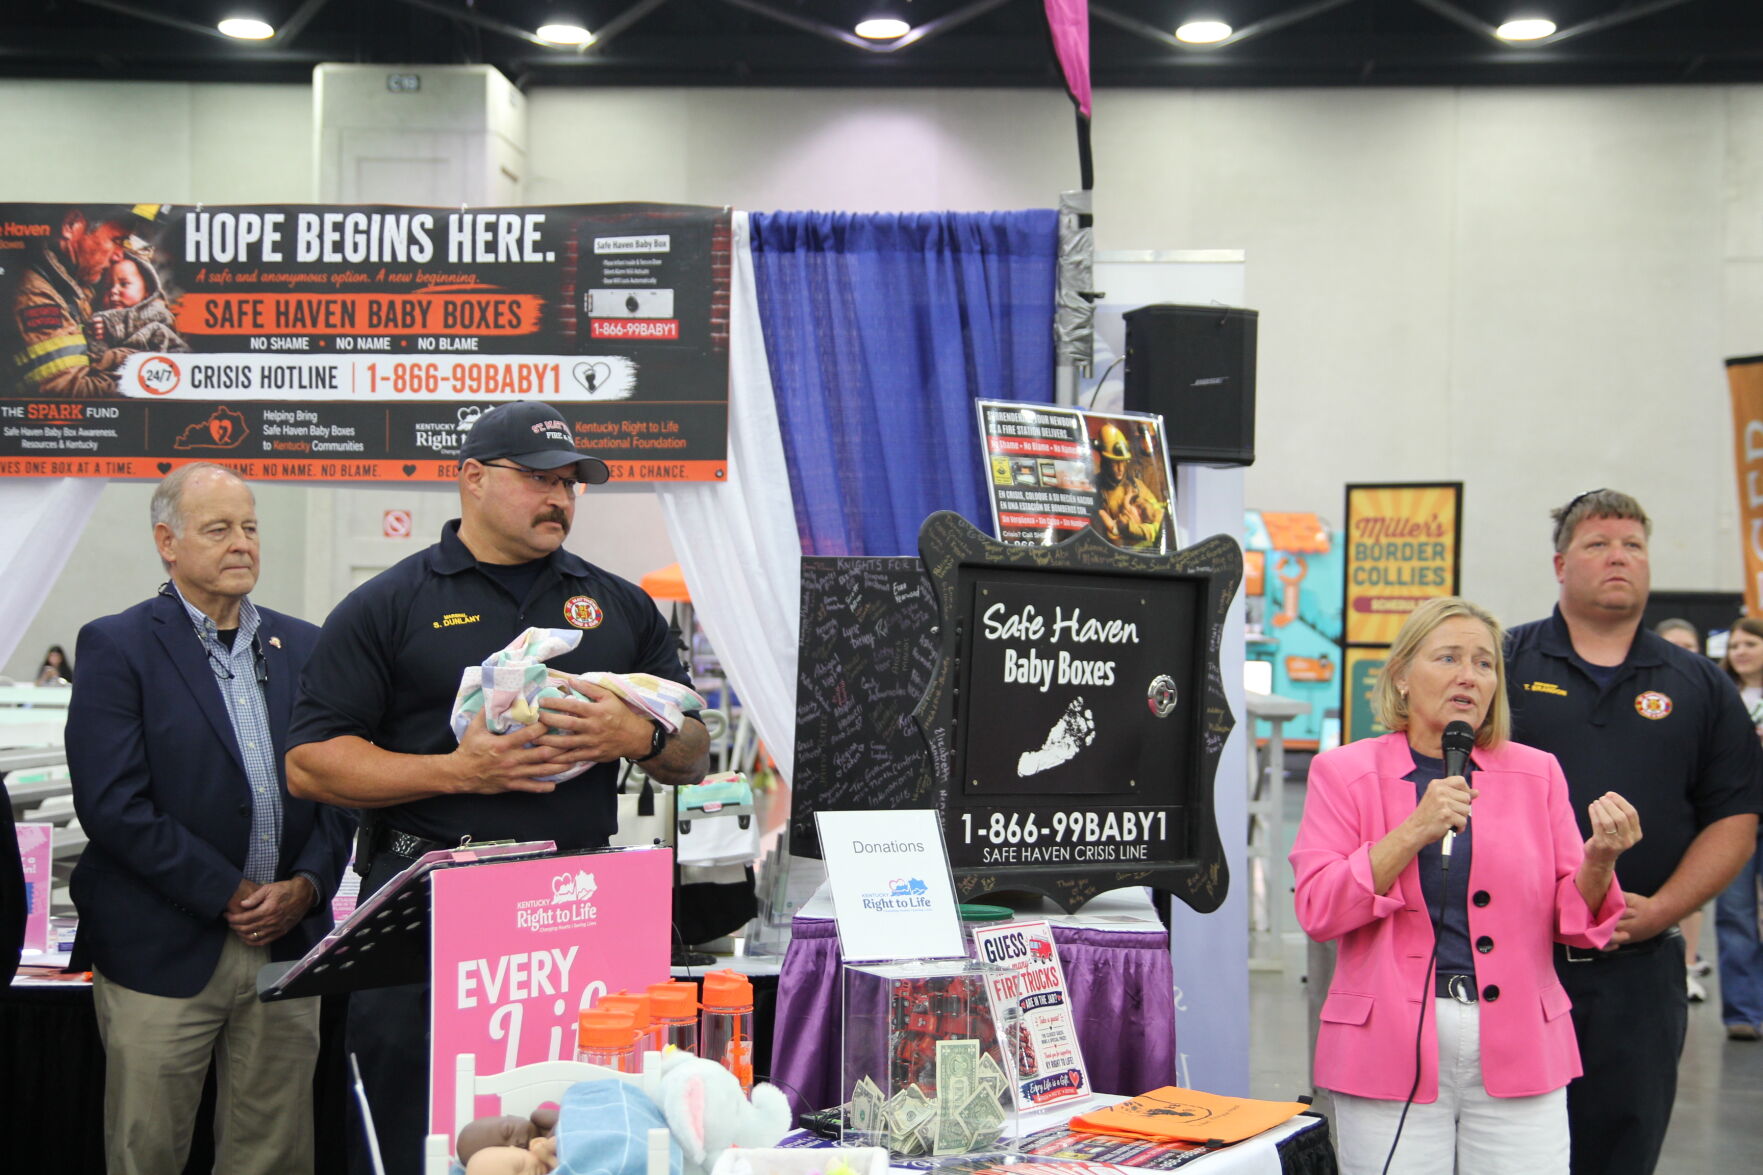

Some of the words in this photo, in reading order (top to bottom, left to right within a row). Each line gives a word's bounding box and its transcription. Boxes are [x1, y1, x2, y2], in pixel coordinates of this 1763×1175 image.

[5, 222, 50, 237] Haven
[186, 213, 285, 263] HOPE
[297, 213, 434, 263] BEGINS
[448, 213, 556, 263] HERE.
[635, 239, 653, 250] Baby
[654, 239, 667, 248] Box
[196, 268, 207, 283] A
[209, 269, 232, 286] safe
[235, 269, 258, 283] and
[261, 273, 327, 288] anonymous
[331, 271, 371, 288] option.
[375, 268, 387, 283] A
[389, 273, 412, 283] new
[416, 269, 480, 288] beginning.
[204, 299, 265, 329] SAFE
[275, 299, 356, 329] HAVEN
[368, 299, 433, 329] BABY
[443, 299, 522, 330] BOXES
[594, 321, 676, 336] 1-866-99BABY1
[251, 337, 267, 350] NO
[270, 337, 310, 350] SHAME
[336, 337, 353, 350] NO
[357, 337, 391, 350] NAME
[418, 337, 436, 350] NO
[439, 337, 479, 350] BLAME
[146, 368, 172, 383] 24/7
[191, 365, 252, 389] CRISIS
[260, 365, 338, 389] HOTLINE
[367, 362, 560, 394] 1-866-99BABY1
[1, 407, 25, 418] THE
[27, 404, 83, 419] SPARK
[86, 408, 119, 418] FUND
[263, 410, 295, 423] Helping
[296, 410, 318, 423] Bring
[263, 425, 281, 436] Safe
[282, 425, 309, 436] Haven
[310, 425, 330, 438] Baby
[331, 425, 355, 436] Boxes
[575, 421, 618, 434] Kentucky
[622, 420, 646, 434] Right
[650, 421, 658, 432] to
[661, 421, 680, 432] Life
[263, 440, 272, 451] to
[273, 441, 311, 453] Kentucky
[311, 440, 364, 452] Communities
[416, 431, 458, 451] Right
[575, 437, 630, 448] Educational
[633, 437, 687, 448] Foundation
[25, 462, 46, 474] ONE
[51, 463, 73, 474] BOX
[75, 463, 91, 474] AT
[94, 463, 101, 475] A
[262, 464, 278, 476] NO
[321, 464, 337, 477] NO
[628, 464, 635, 478] A
[1355, 513, 1446, 541] Miller's
[1355, 542, 1446, 562] BORDER
[1353, 567, 1446, 586] COLLIES
[433, 621, 442, 629] S.
[983, 603, 1045, 641] Safe
[1050, 606, 1139, 643] Haven
[1004, 648, 1055, 692] Baby
[1058, 651, 1116, 686] Boxes
[961, 811, 1167, 844] 1-866-99BABY1
[853, 841, 925, 854] Donations
[983, 848, 1017, 863] SAFE
[1022, 847, 1070, 862] HAVEN
[1074, 845, 1115, 861] CRISIS
[1120, 845, 1147, 859] LINE
[517, 899, 550, 909] KENTUCKY
[863, 898, 894, 912] Right
[896, 898, 908, 908] to
[910, 896, 931, 907] Life
[517, 908, 553, 931] Right
[556, 908, 570, 923] to
[572, 902, 597, 921] Life
[984, 932, 1027, 963] GUESS
[457, 946, 579, 1009] EVERY
[993, 975, 1022, 1001] FIRE
[1020, 966, 1059, 994] TRUCKS
